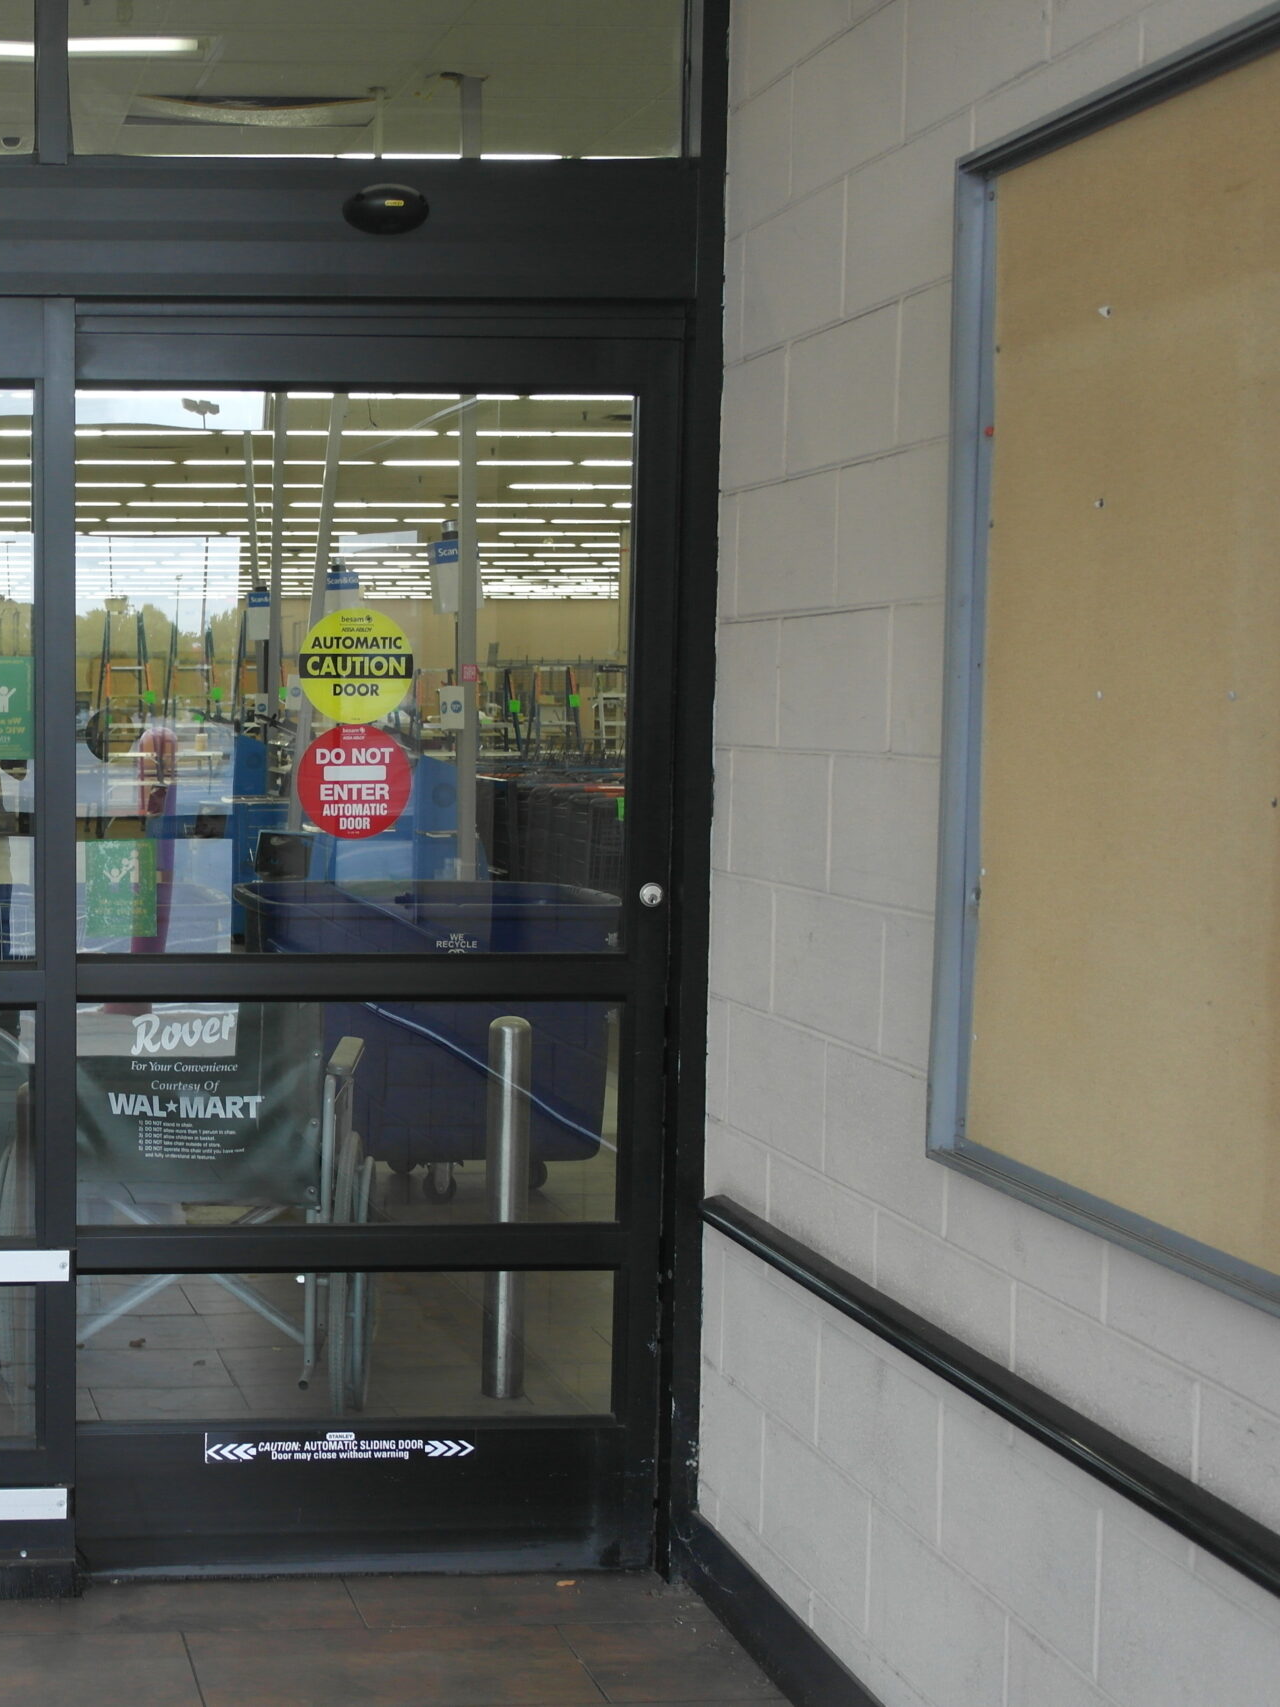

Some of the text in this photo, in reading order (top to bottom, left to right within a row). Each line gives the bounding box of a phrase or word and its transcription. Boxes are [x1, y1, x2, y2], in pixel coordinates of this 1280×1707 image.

[311, 636, 402, 649] AUTOMATIC
[306, 656, 406, 676] CAUTION
[333, 683, 380, 696] DOOR
[315, 747, 394, 764] DO NOT
[320, 784, 390, 801] ENTER
[322, 803, 388, 816] AUTOMATIC
[339, 817, 371, 830] DOOR
[449, 933, 465, 941] WE
[131, 1012, 236, 1055] Rover
[131, 1061, 238, 1073] For Your Convenience
[151, 1080, 220, 1093] Courtesy Of
[258, 1439, 423, 1451] CAUTION: AUTOMATIC SLIDING DOOR
[271, 1450, 410, 1461] Door may close without warning
